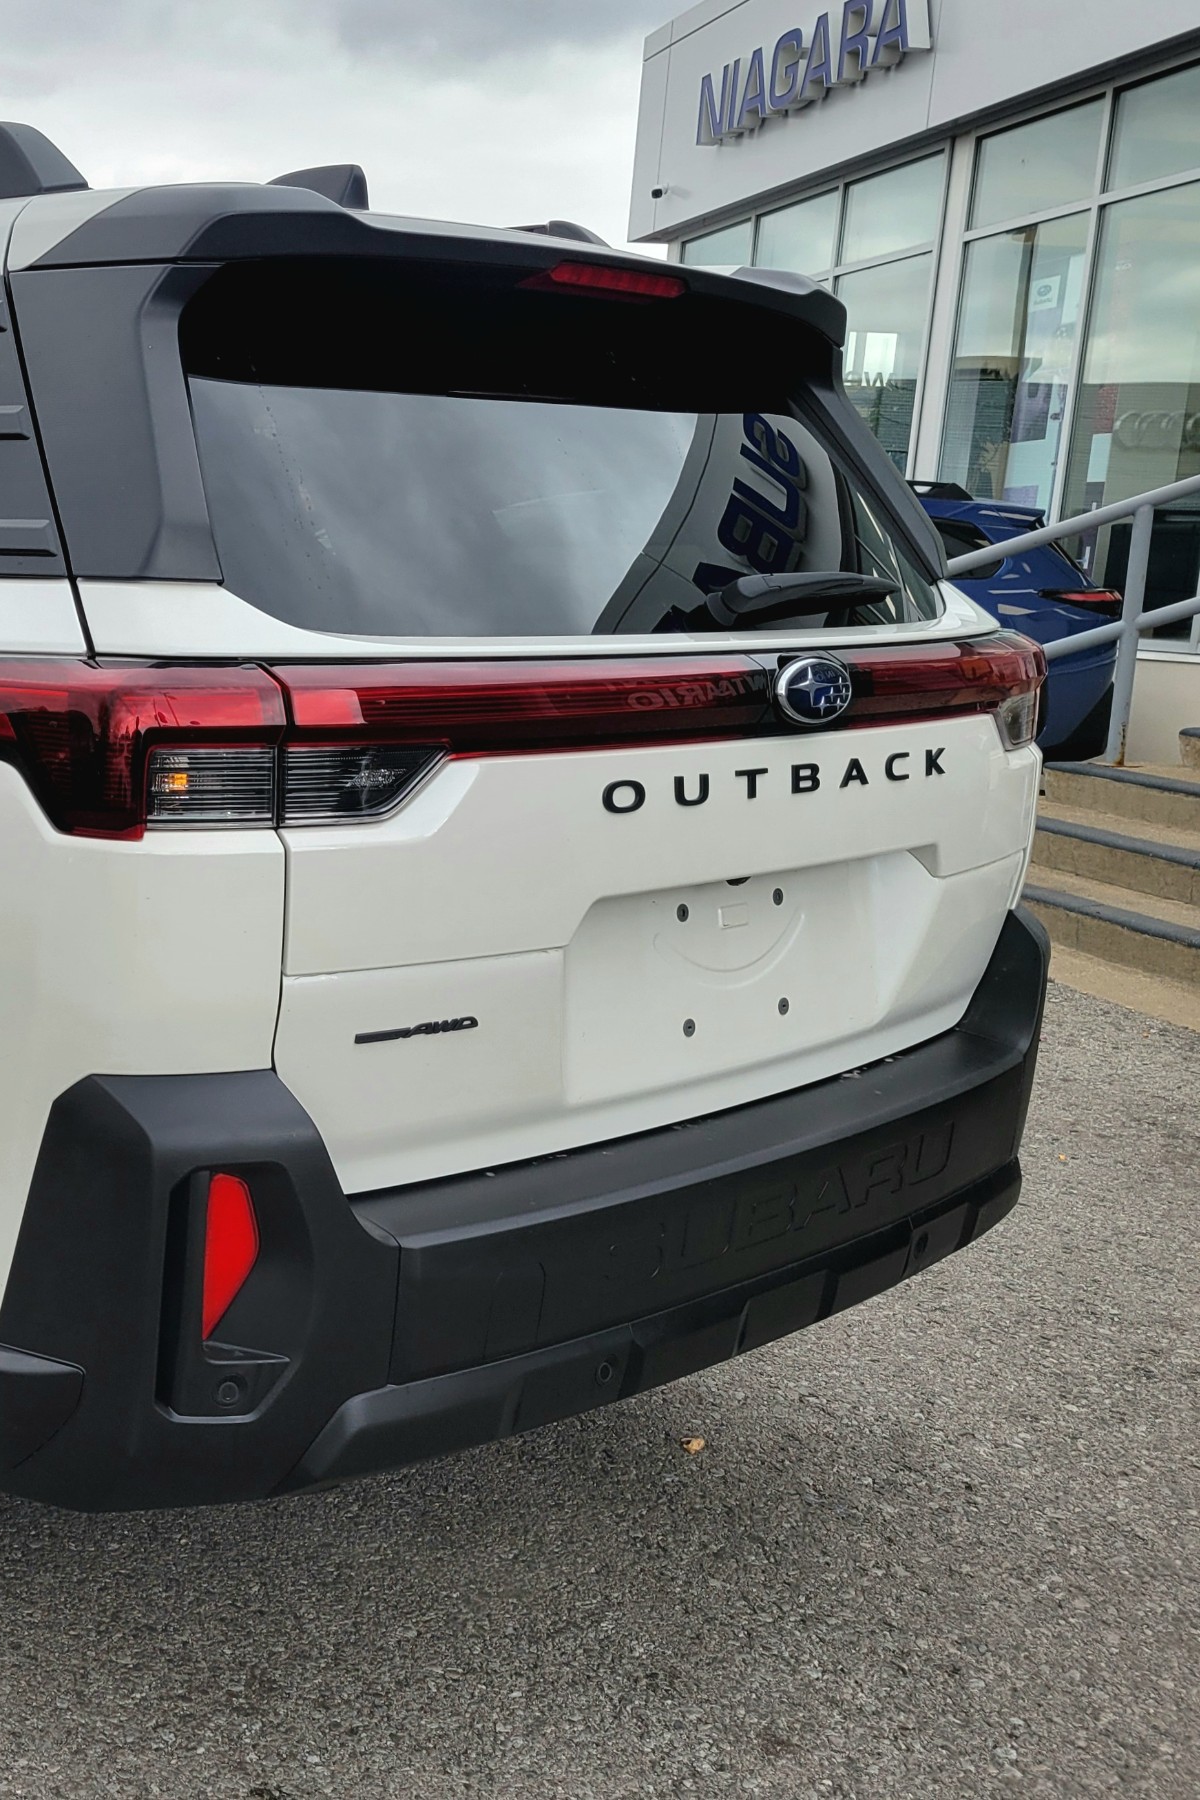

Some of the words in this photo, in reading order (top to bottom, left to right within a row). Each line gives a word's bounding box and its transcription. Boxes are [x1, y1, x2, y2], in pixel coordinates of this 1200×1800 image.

[696, 0, 922, 146] NIAGARA
[601, 747, 947, 814] OUTBACK
[398, 1016, 479, 1039] AWD
[599, 1119, 955, 1284] SUBARU
